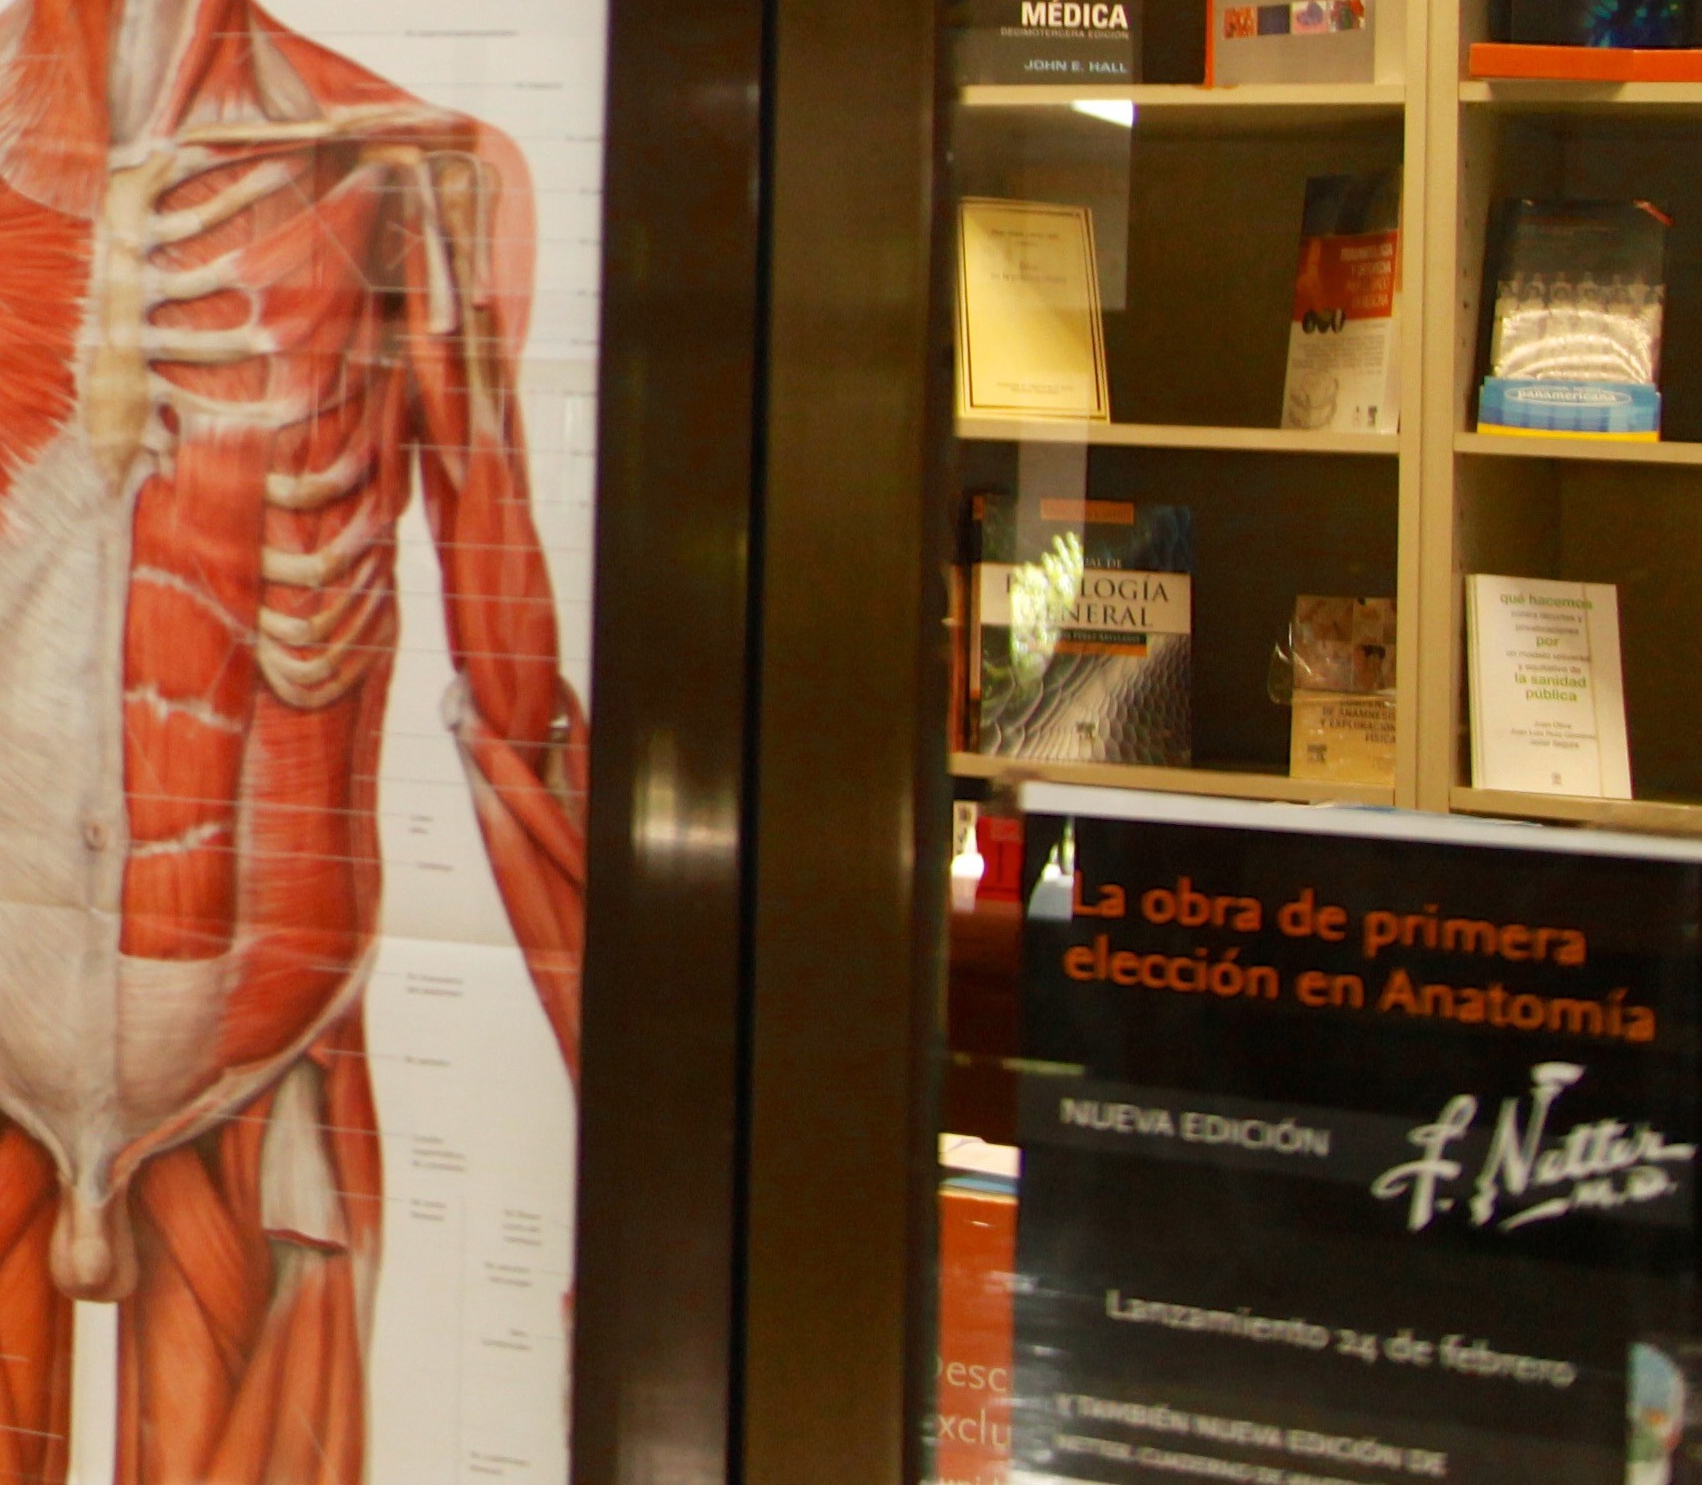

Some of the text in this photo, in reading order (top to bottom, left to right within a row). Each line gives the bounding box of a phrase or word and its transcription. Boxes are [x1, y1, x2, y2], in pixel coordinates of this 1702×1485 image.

[1024, 59, 1067, 72] JOHN
[1089, 61, 1128, 74] HALL
[1517, 387, 1616, 403] panamericana
[1500, 593, 1594, 609] qué hacemos
[1536, 635, 1560, 648] por
[1514, 672, 1587, 688] la sanidad
[1526, 687, 1578, 703] pública
[1072, 871, 1588, 967] La obra de primera
[1063, 934, 1656, 1044] elección en Anatomía
[1059, 1096, 1333, 1158] NUEVA EDICIÓN
[1105, 1288, 1578, 1388] Lanzamiento 24 de febrero
[1077, 1393, 1191, 1434] TAMBIÉN
[1194, 1415, 1282, 1453] NUEVA
[1288, 1427, 1402, 1469] EDICIÓN
[1406, 1447, 1448, 1478] DE
